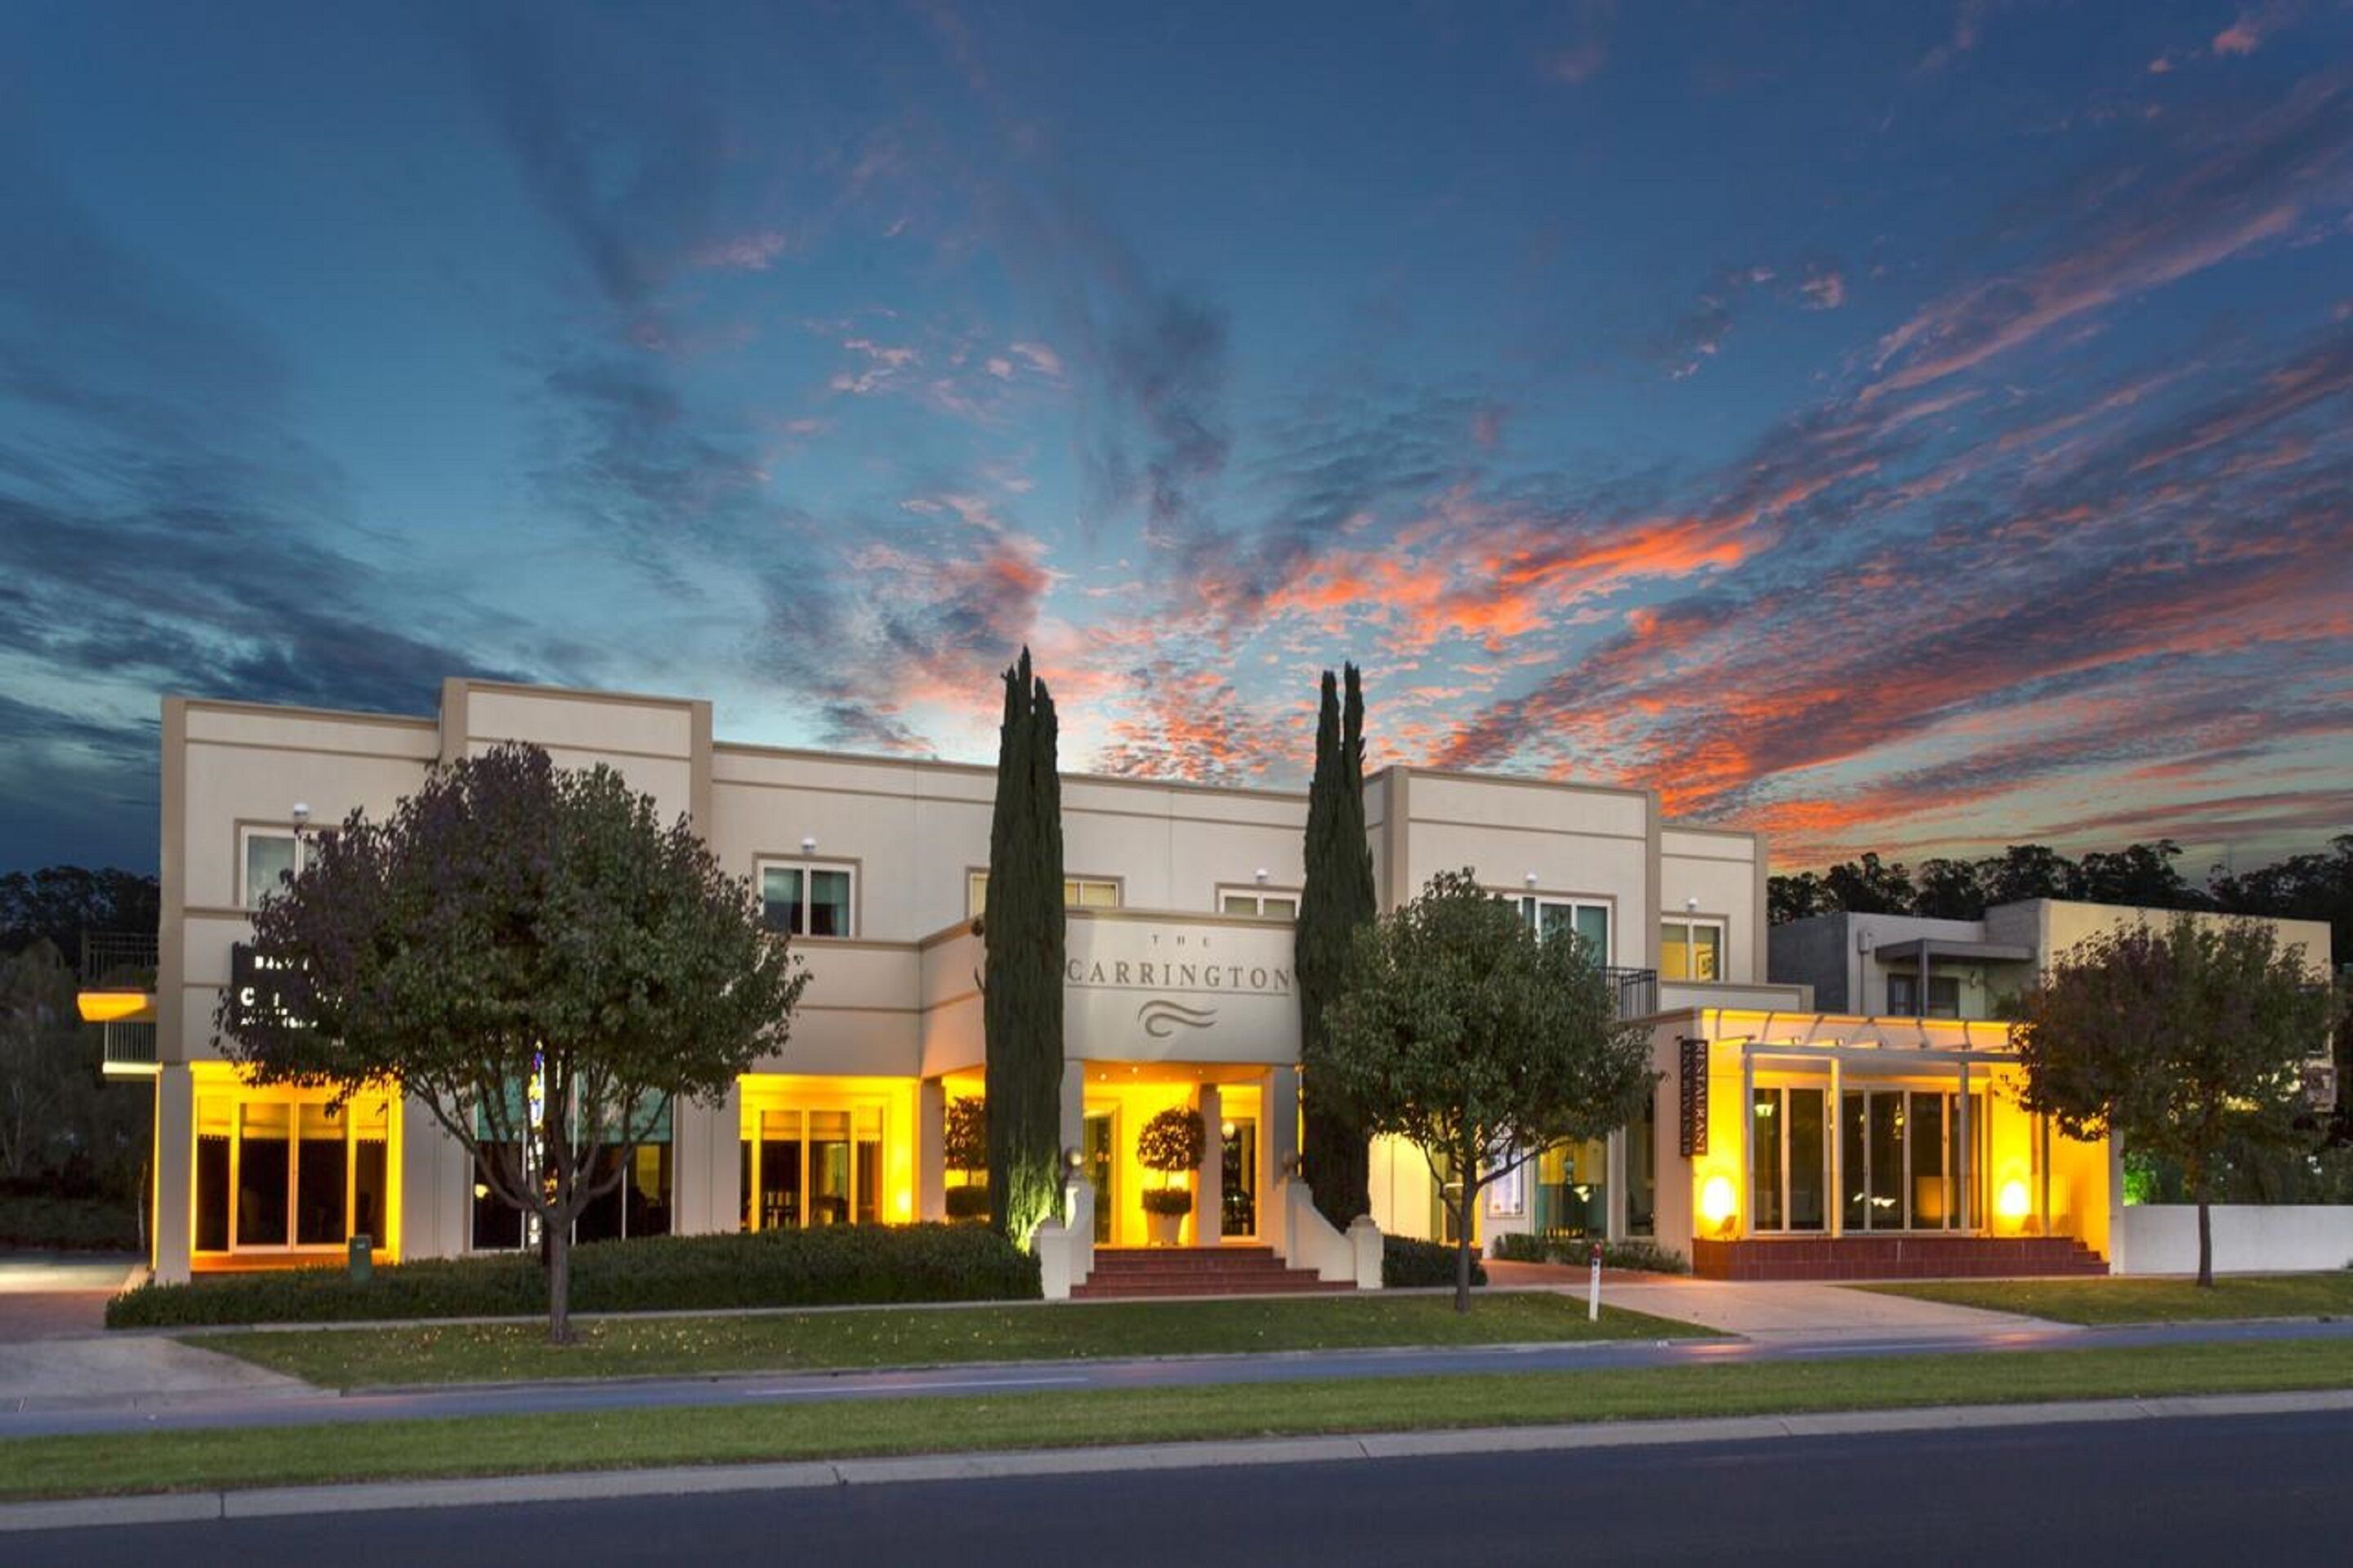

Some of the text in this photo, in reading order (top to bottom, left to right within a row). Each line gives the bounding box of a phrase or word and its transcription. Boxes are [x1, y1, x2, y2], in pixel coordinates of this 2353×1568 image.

[1152, 934, 1209, 947] THE
[1066, 958, 1293, 989] CARRINGTON
[1694, 1043, 1706, 1152] RESTAURANT
